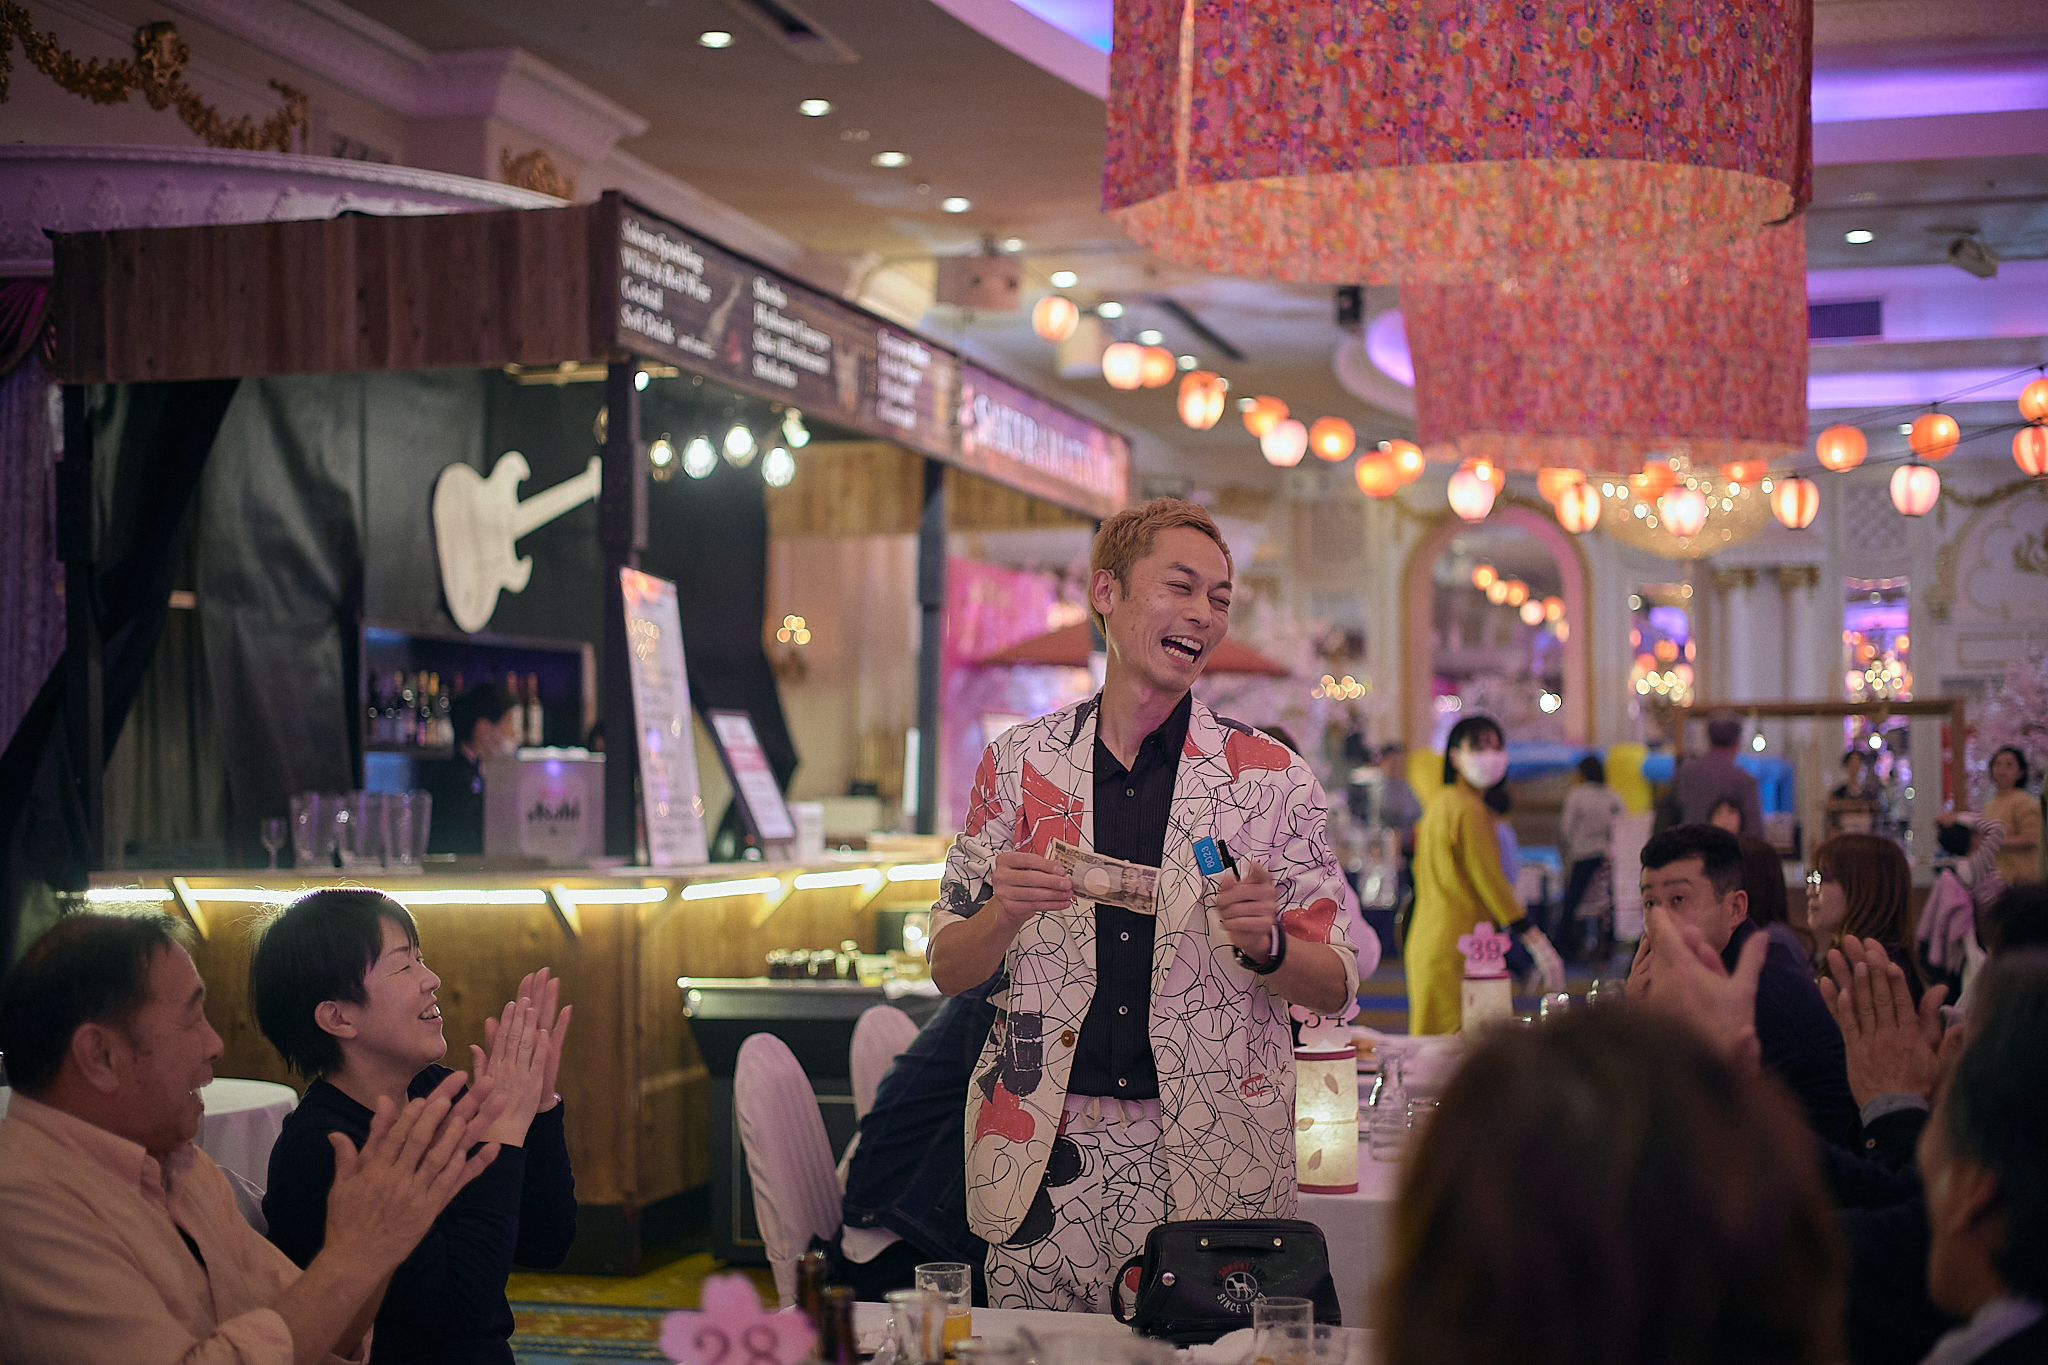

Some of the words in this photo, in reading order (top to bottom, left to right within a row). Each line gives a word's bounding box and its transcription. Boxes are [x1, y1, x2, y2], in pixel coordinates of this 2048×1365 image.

[620, 275, 663, 312] Cocktail
[686, 272, 712, 304] Wine
[620, 303, 643, 332] Soft
[1201, 845, 1215, 868] 8023
[1469, 938, 1501, 963] 39
[1216, 1293, 1242, 1314] SINCE
